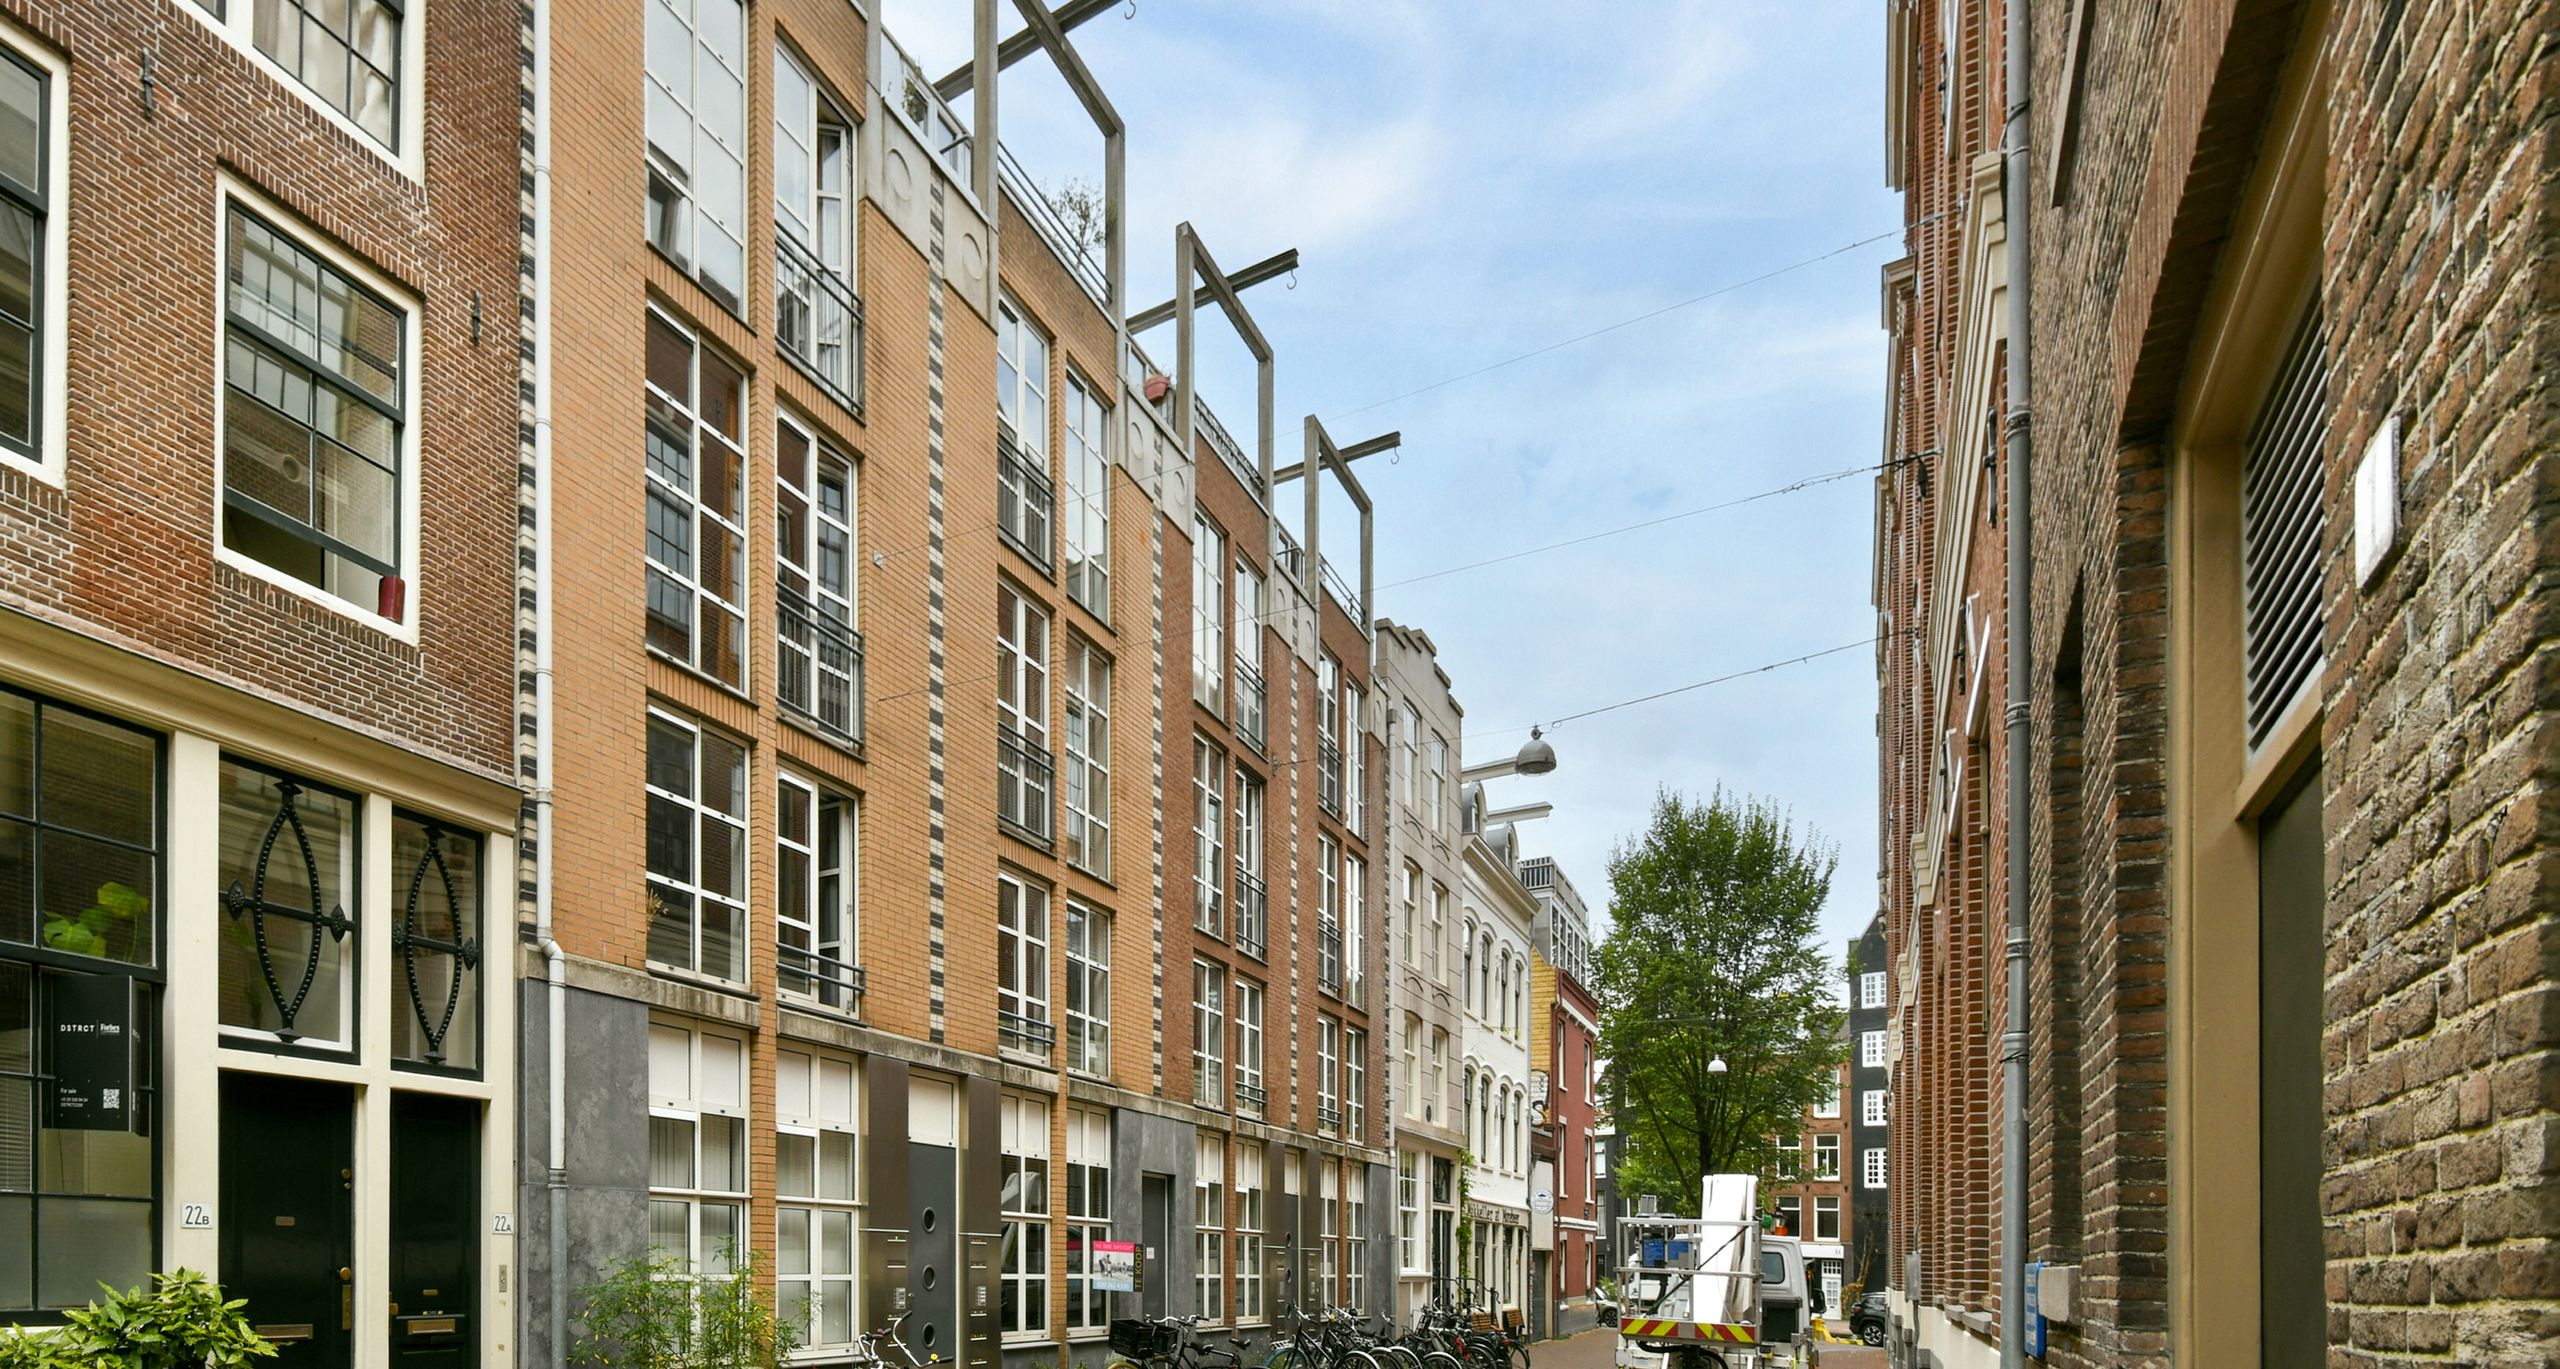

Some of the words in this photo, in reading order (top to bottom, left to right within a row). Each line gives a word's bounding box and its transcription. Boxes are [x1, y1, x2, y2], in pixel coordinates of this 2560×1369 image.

[60, 1024, 95, 1032] DSTRCT
[185, 1205, 210, 1225] 22B
[494, 1215, 511, 1231] 22A
[1135, 1246, 1143, 1275] KOOP
[1135, 1278, 1142, 1288] TE
